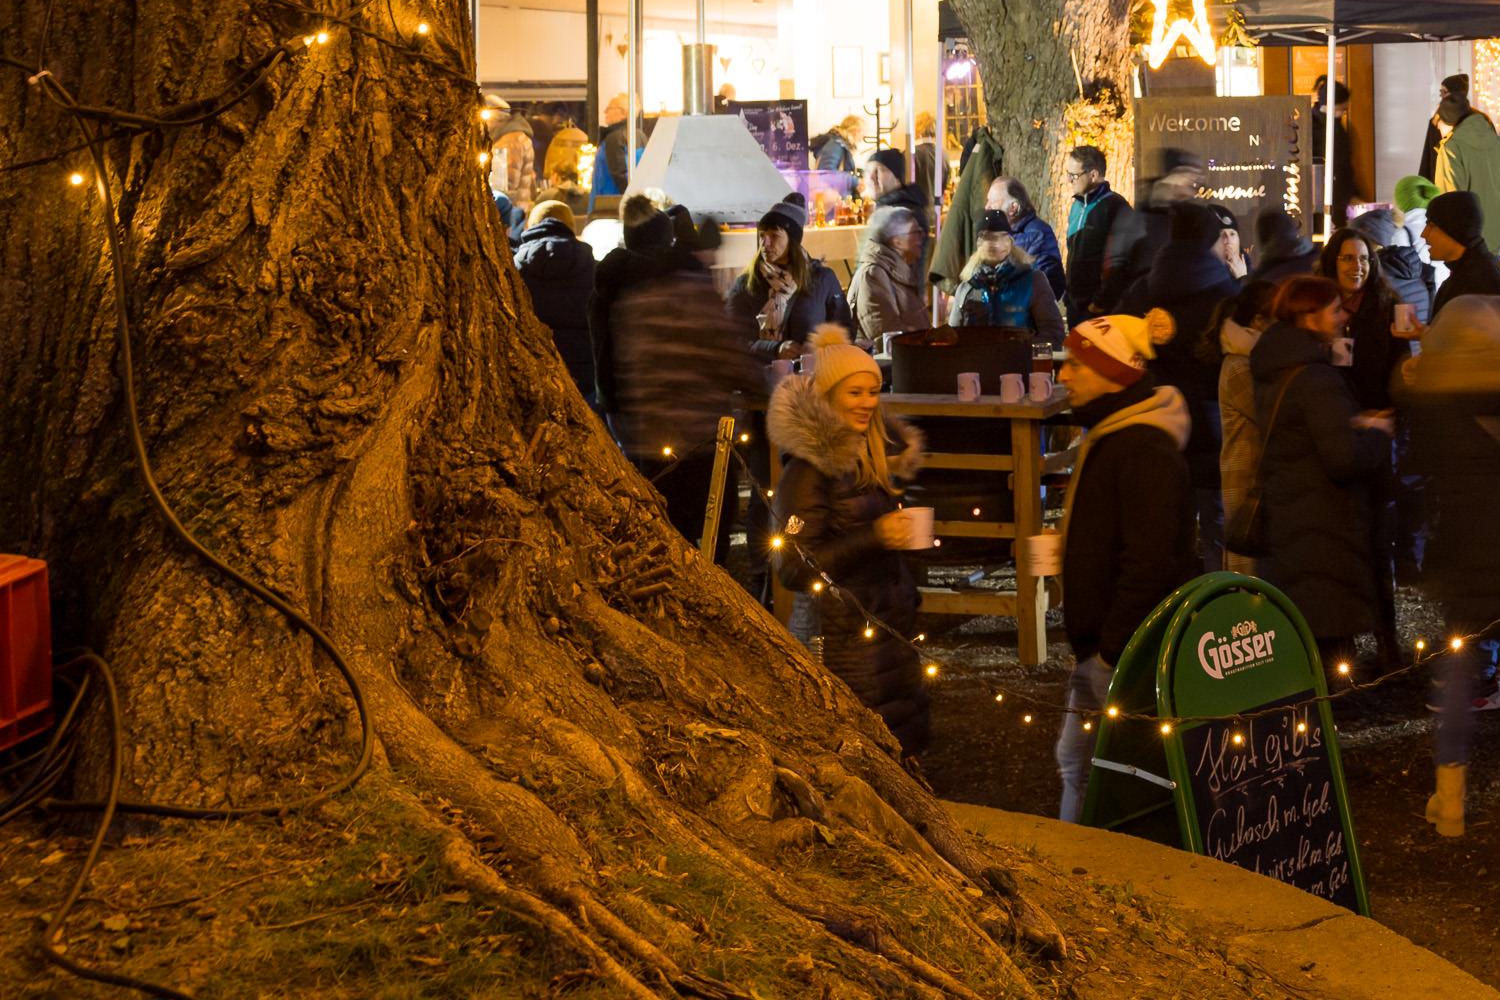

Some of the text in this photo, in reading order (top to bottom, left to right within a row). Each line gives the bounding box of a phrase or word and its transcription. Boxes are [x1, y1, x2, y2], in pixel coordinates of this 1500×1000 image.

[1150, 111, 1240, 131] Welcome
[785, 141, 804, 151] Dez.
[1193, 183, 1266, 200] envenue
[1197, 630, 1276, 680] Gösser
